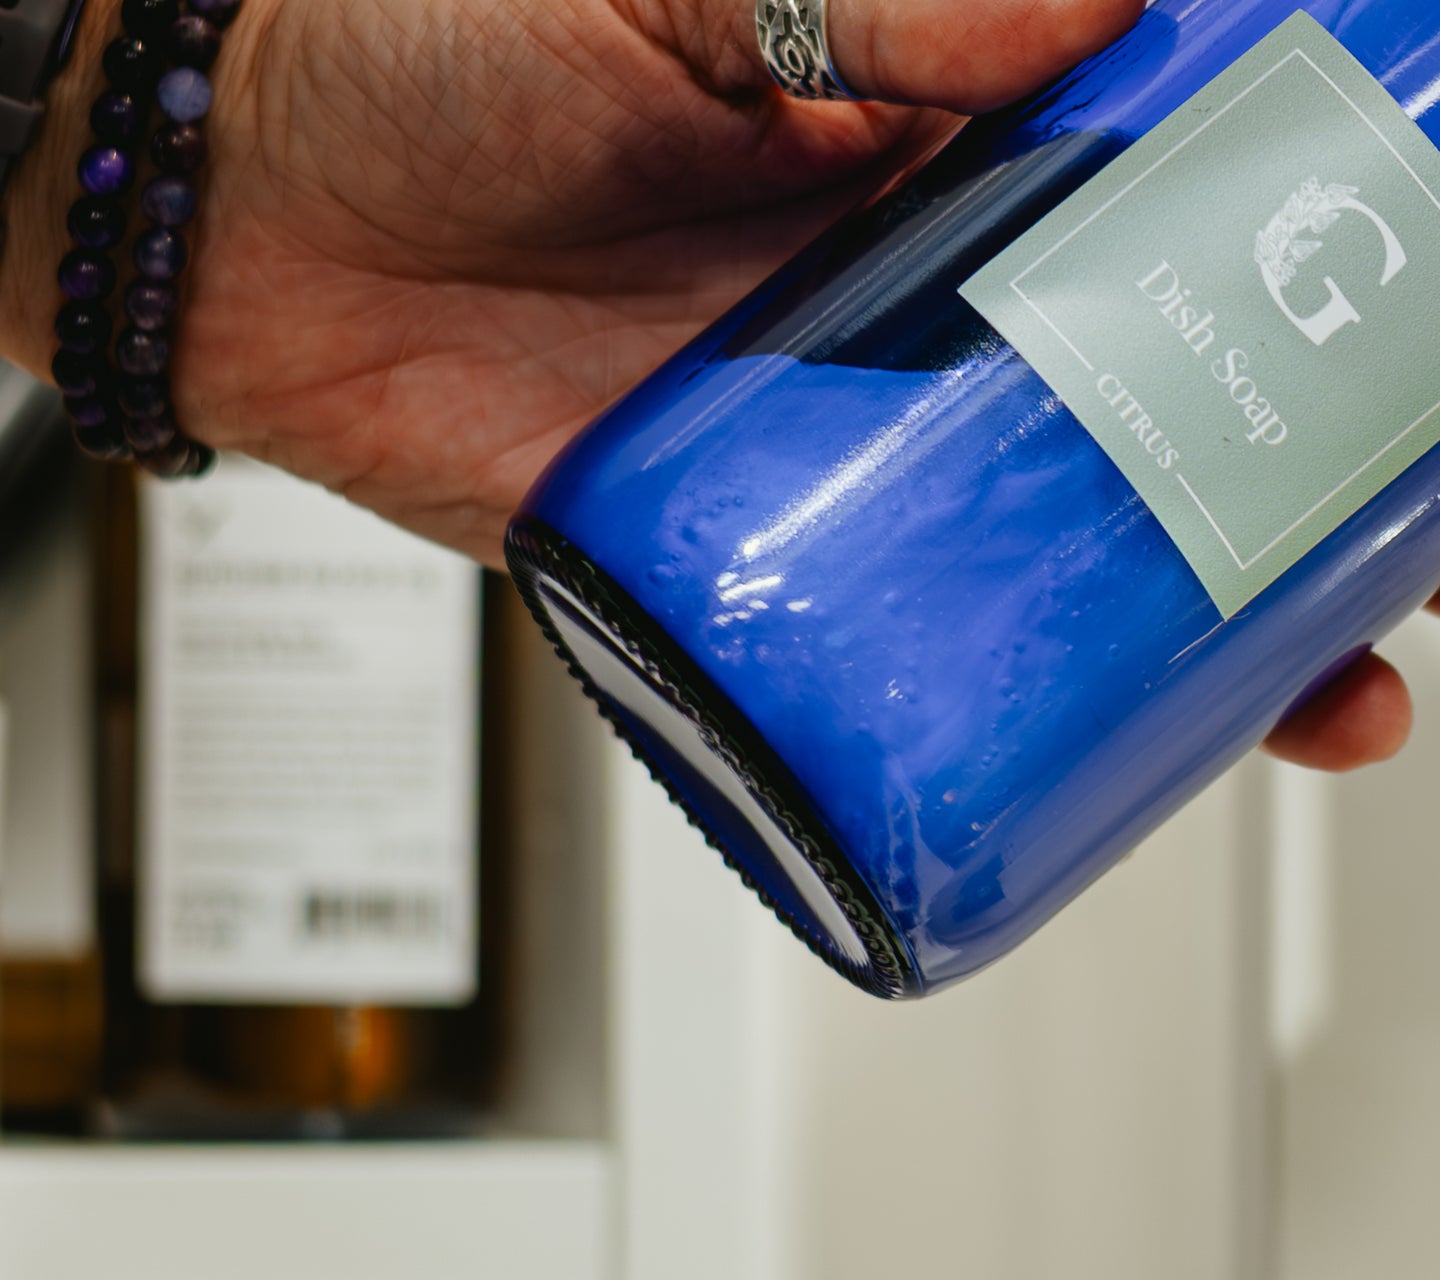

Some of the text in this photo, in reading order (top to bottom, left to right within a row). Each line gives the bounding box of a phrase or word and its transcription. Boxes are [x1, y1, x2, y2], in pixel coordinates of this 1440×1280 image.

[1254, 176, 1408, 346] G
[1096, 373, 1180, 469] CITRUS
[1135, 257, 1288, 446] Dish Soap
